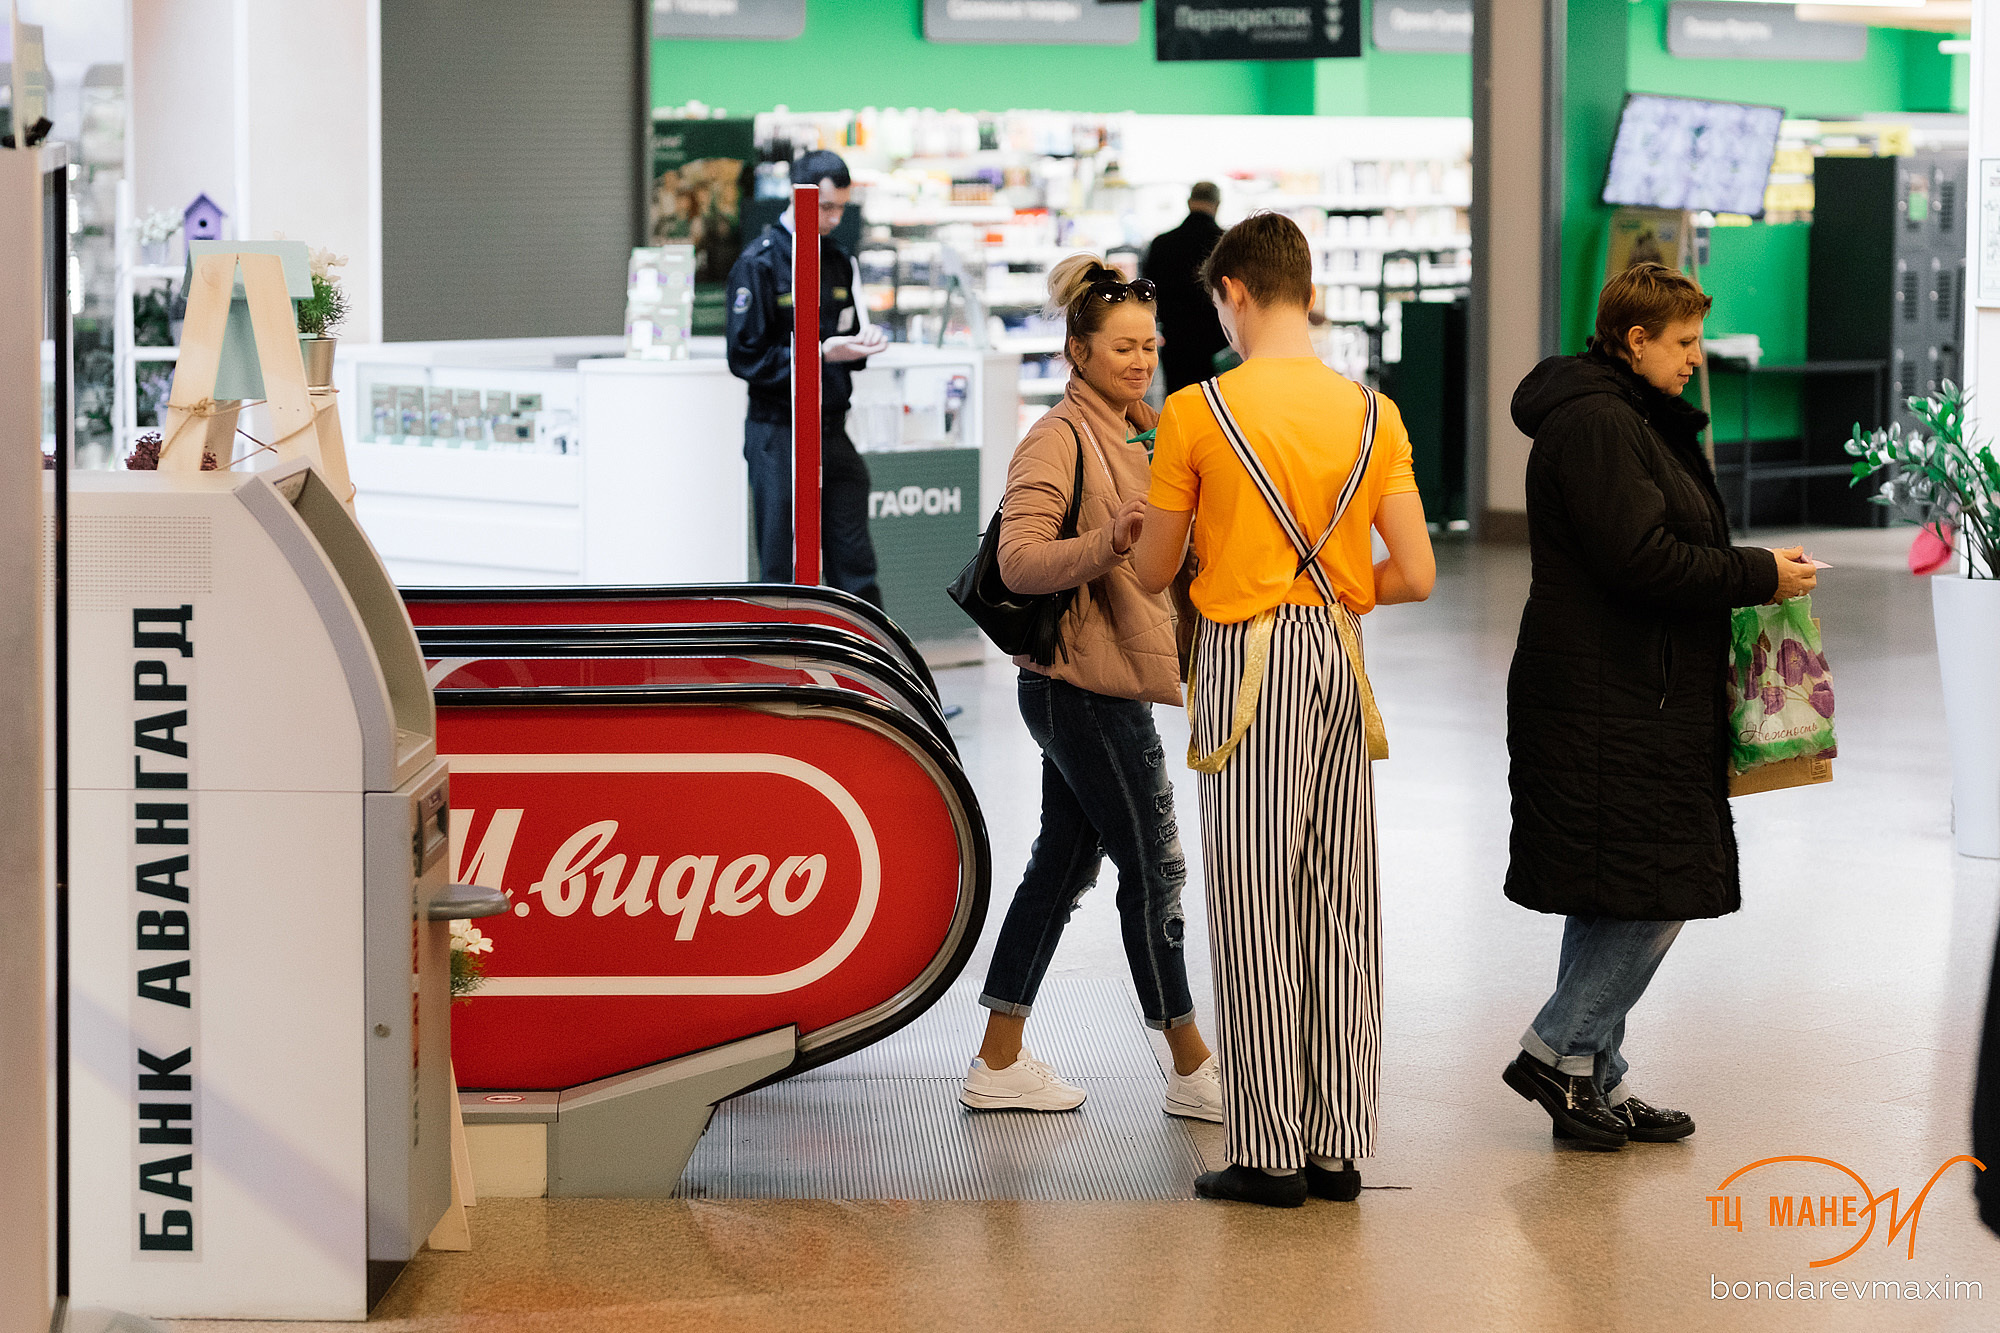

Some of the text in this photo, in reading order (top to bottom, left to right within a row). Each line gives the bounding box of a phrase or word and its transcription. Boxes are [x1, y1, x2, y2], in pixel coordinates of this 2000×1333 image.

[867, 485, 962, 519] ГАФОН
[1739, 720, 1819, 744] Нежность
[132, 602, 195, 1252] БАНК АВАНГАРД
